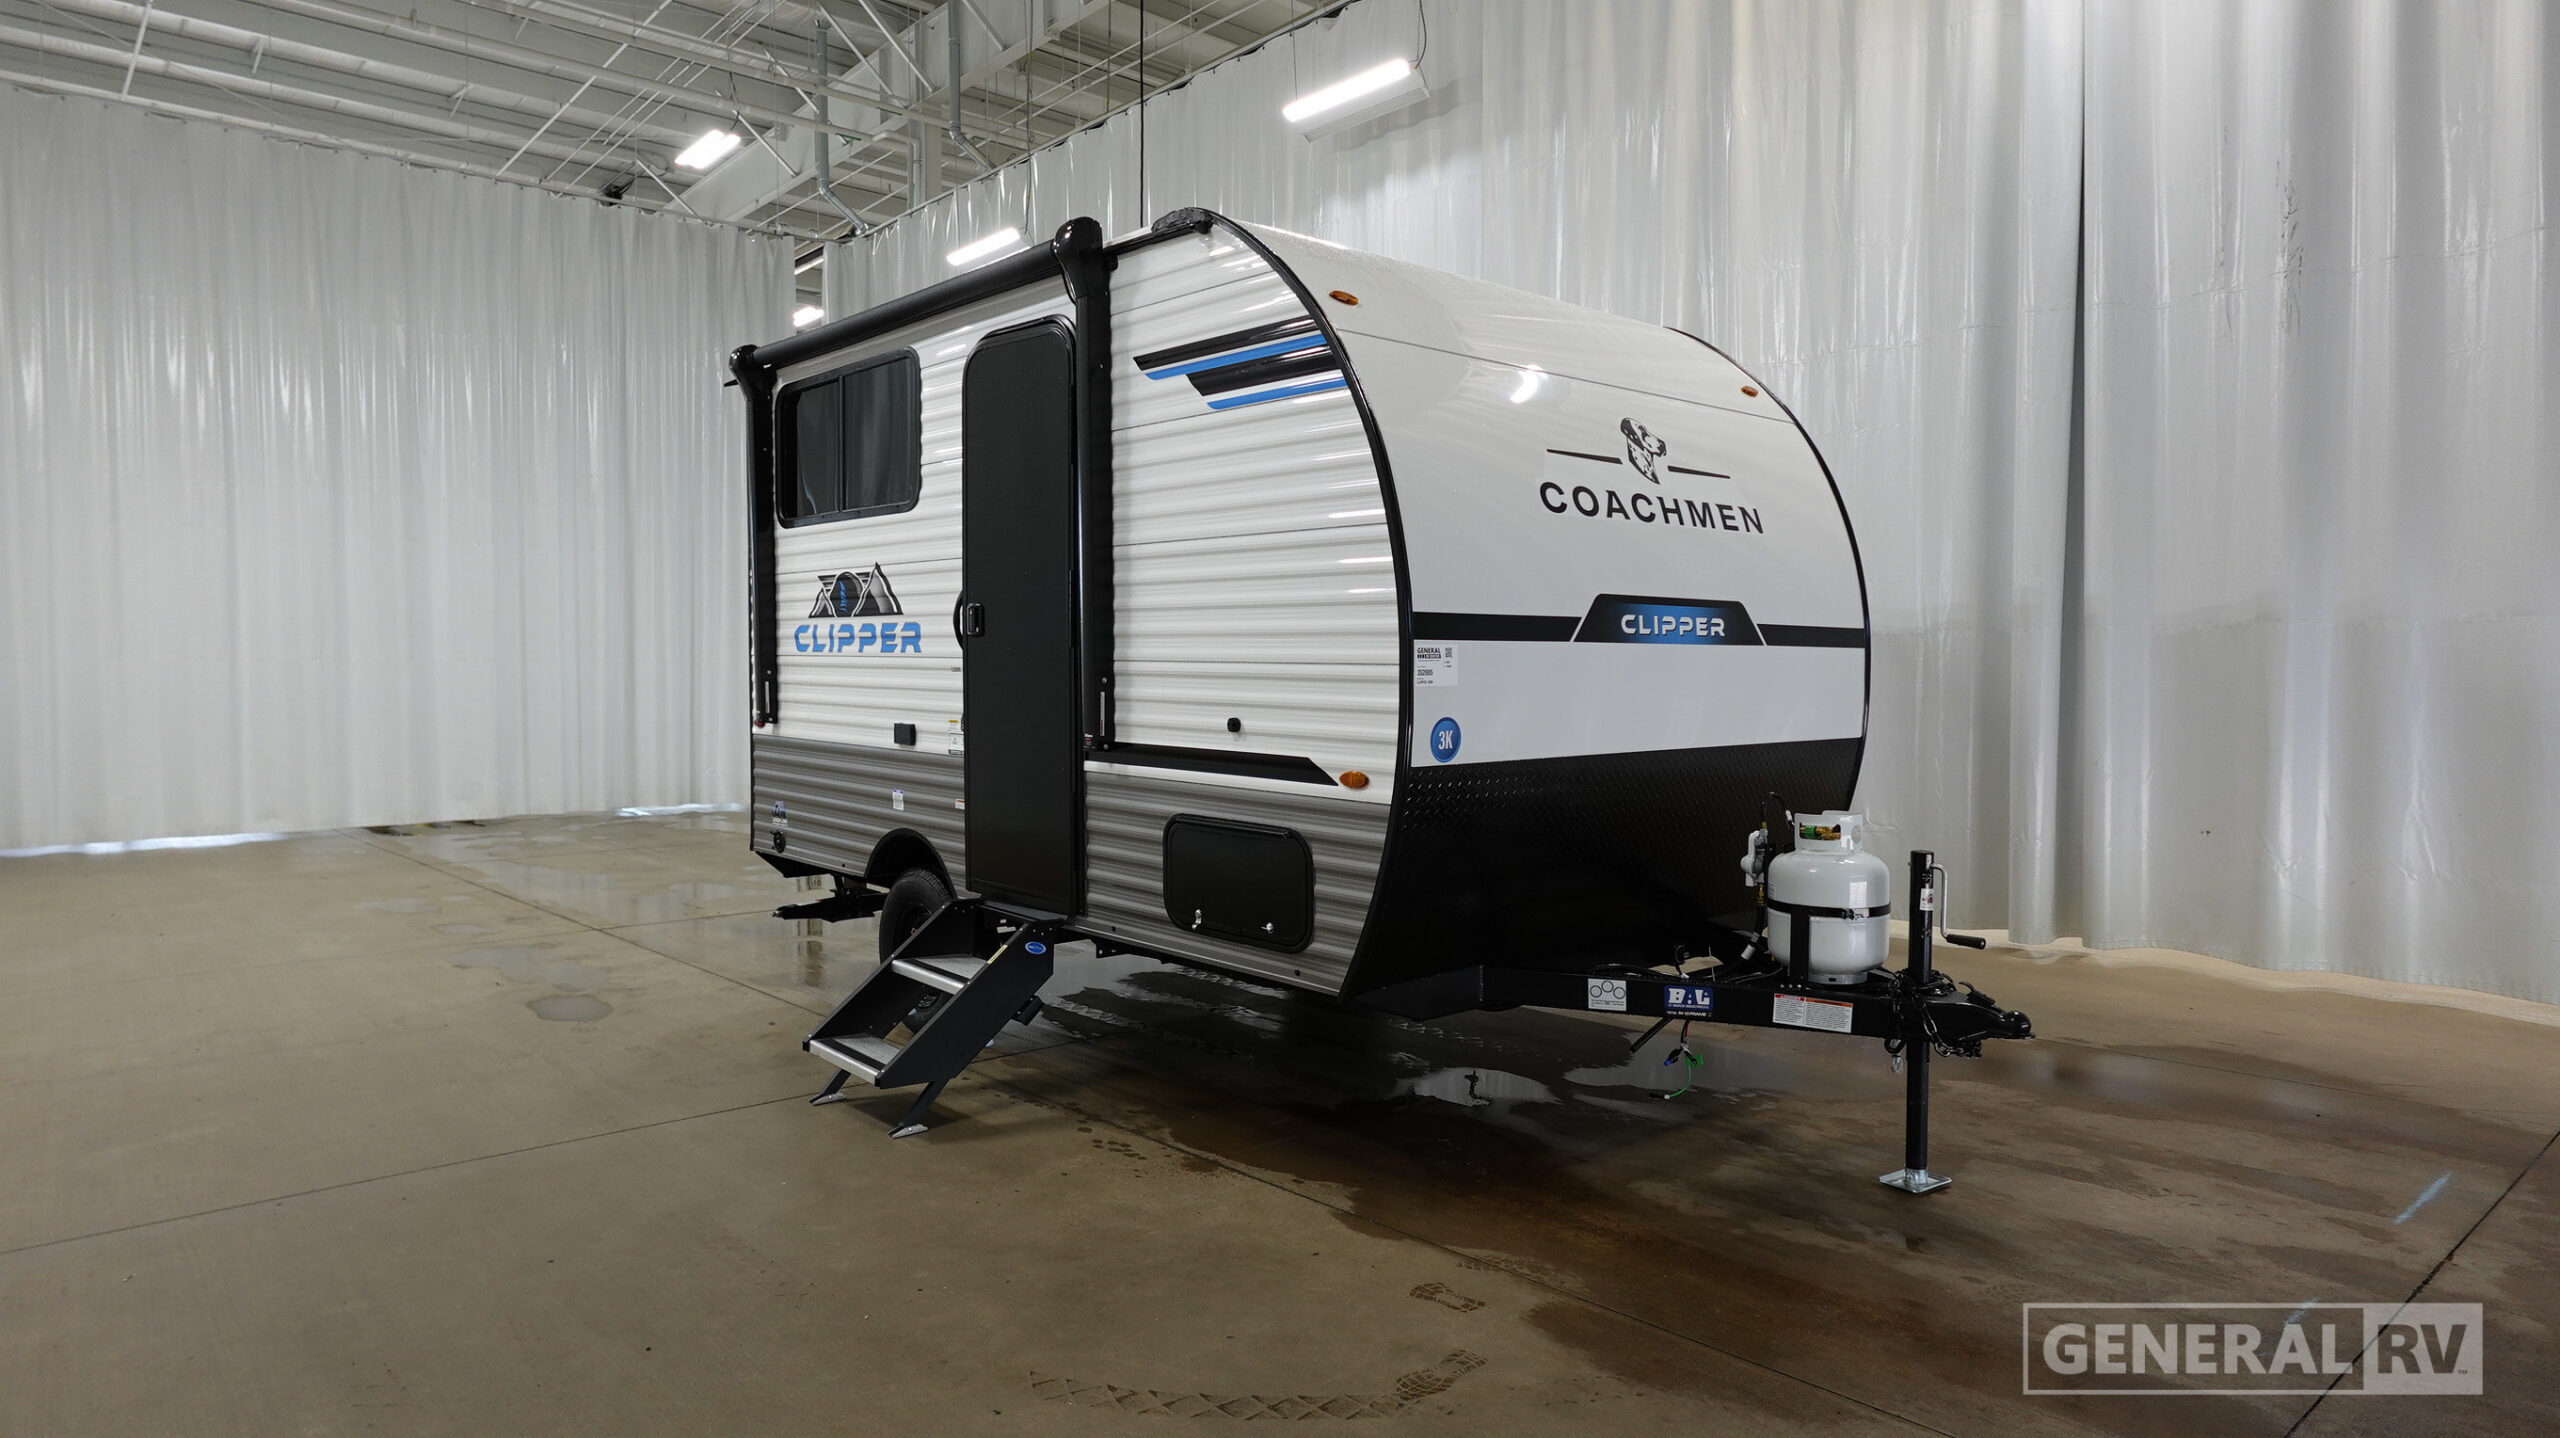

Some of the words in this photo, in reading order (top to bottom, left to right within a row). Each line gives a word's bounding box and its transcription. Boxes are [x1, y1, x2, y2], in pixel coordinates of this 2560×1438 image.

[1539, 481, 1764, 534] COACHMEN
[793, 621, 922, 654] CLIPPER
[1620, 614, 1726, 637] CLIPPER
[1438, 730, 1454, 750] 3K
